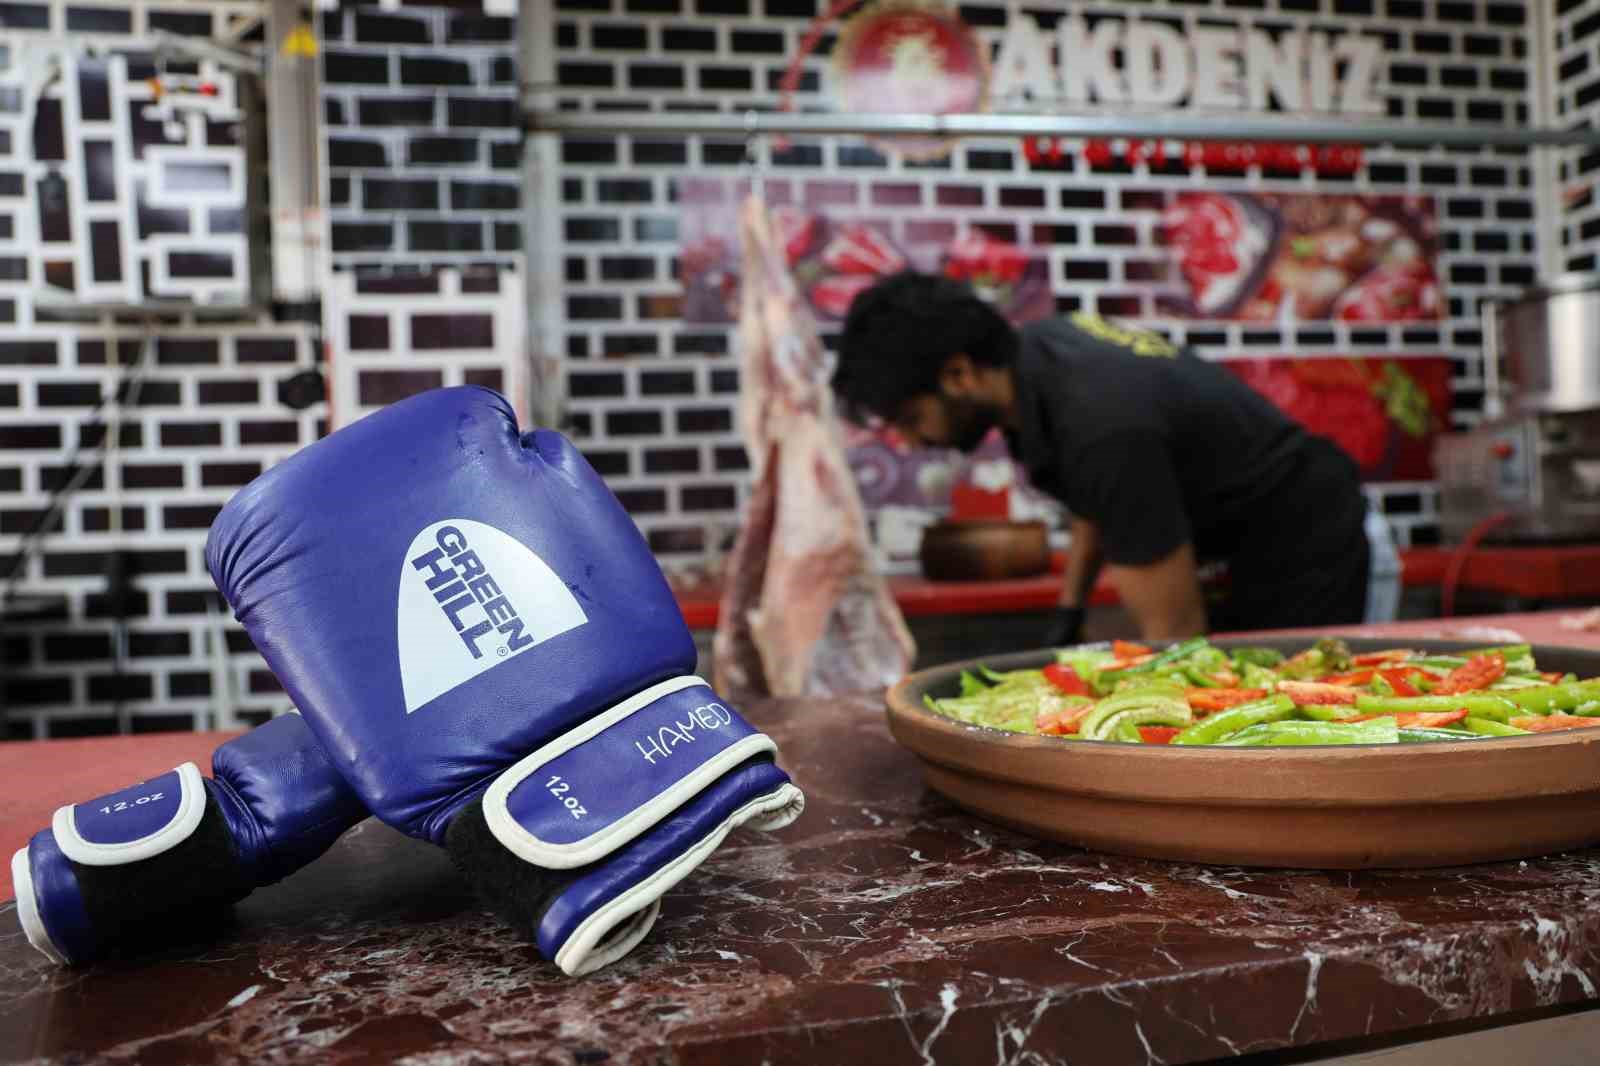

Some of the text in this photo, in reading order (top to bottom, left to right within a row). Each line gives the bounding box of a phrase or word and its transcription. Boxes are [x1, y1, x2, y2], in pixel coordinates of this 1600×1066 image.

[411, 547, 483, 659] HILL
[435, 525, 534, 652] GREEN
[635, 702, 731, 764] HAMED
